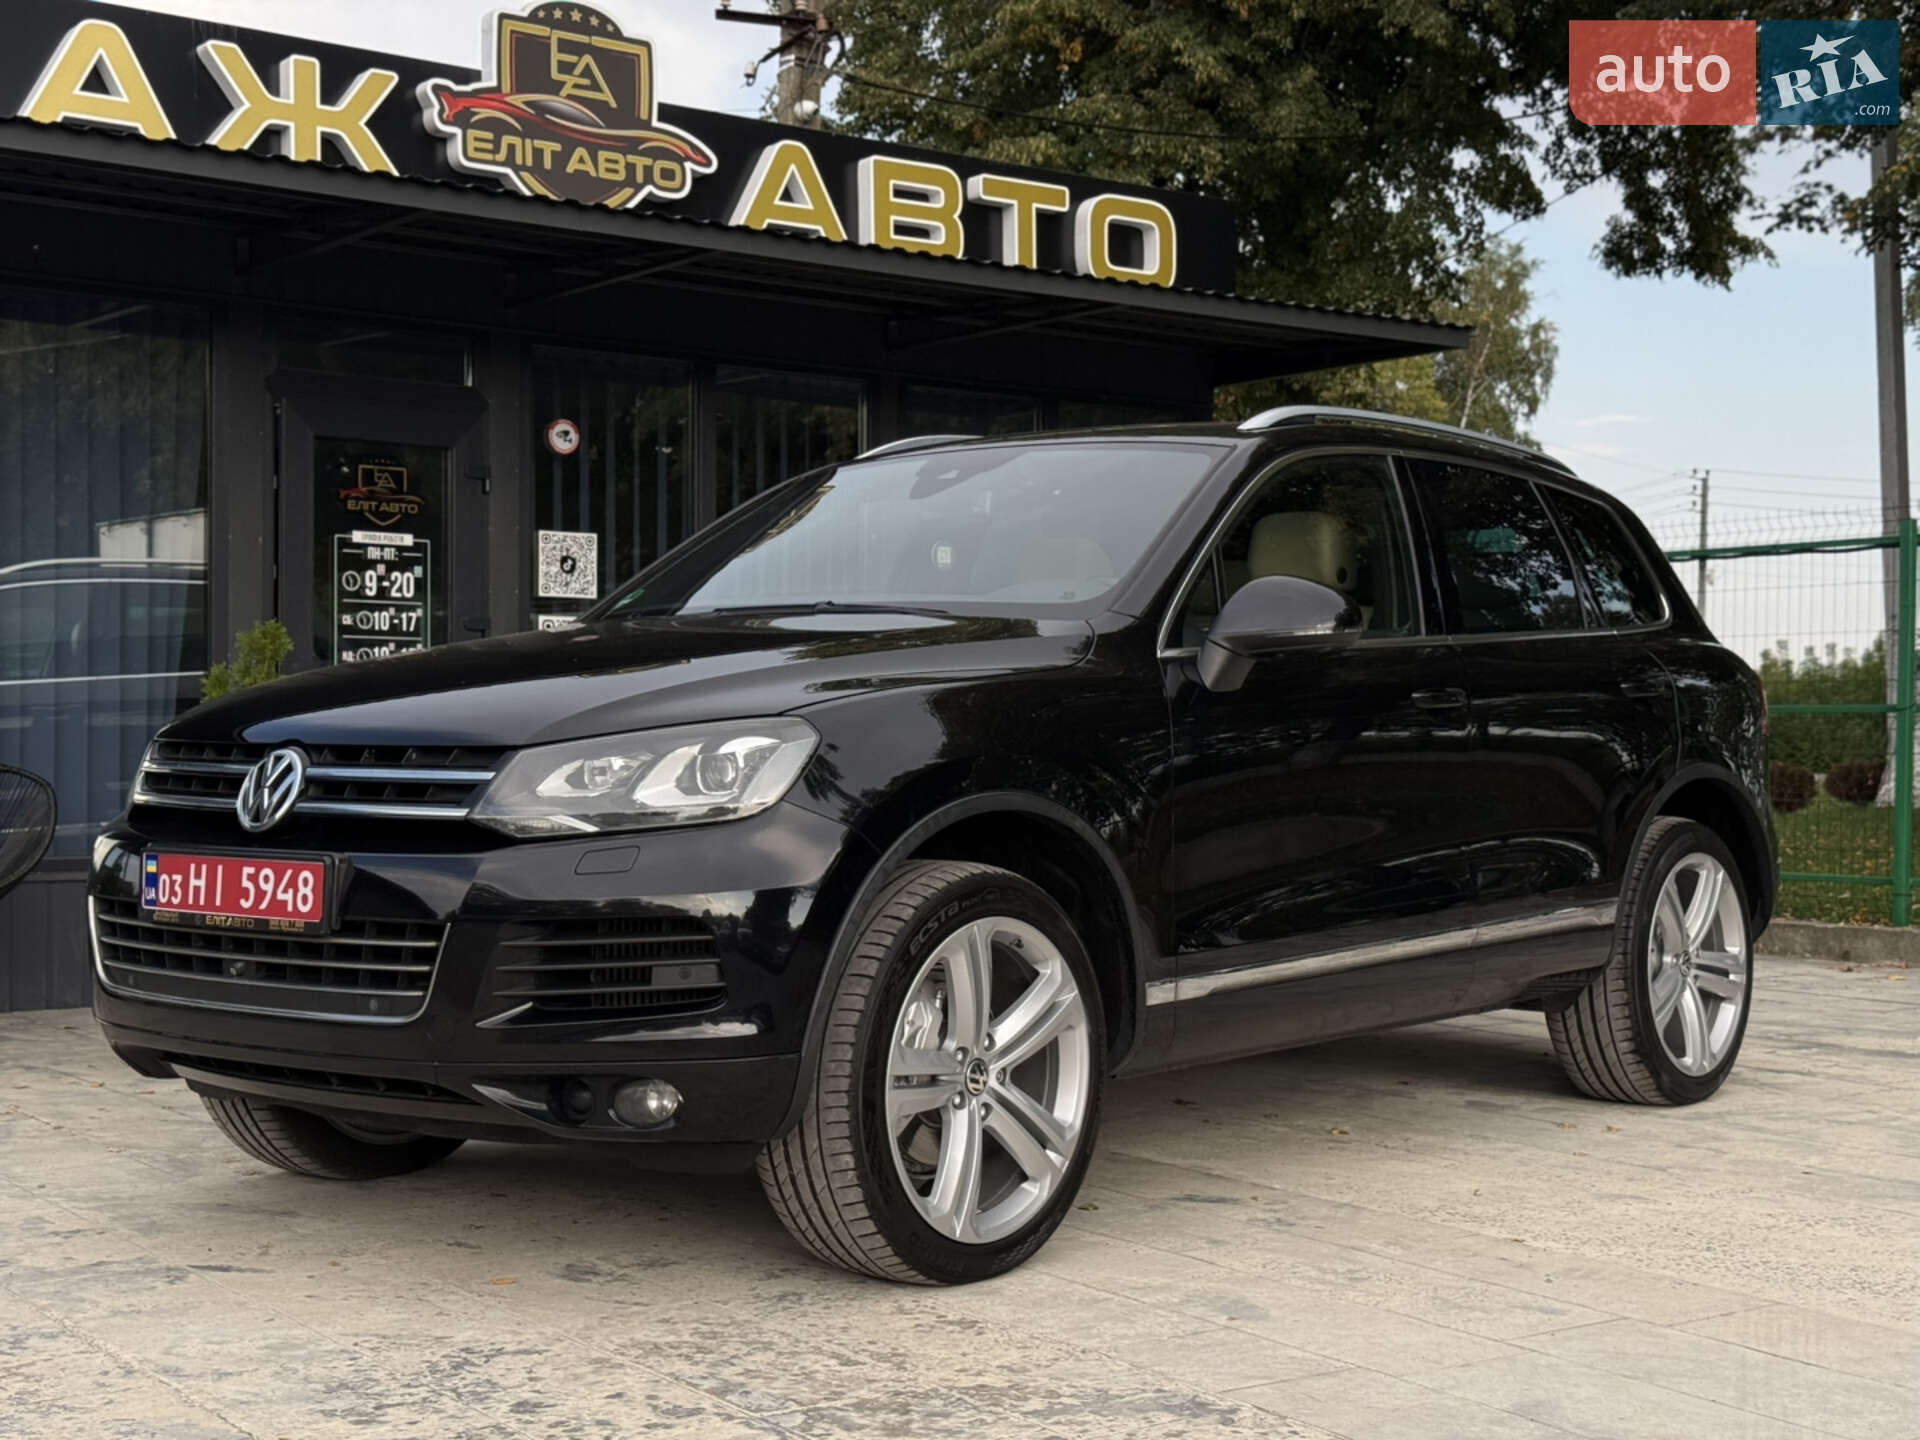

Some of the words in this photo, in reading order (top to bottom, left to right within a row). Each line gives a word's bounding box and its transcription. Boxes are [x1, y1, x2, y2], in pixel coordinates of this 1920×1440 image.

[466, 128, 562, 170] ЕЛІТ
[565, 146, 683, 189] АВТО
[728, 139, 1177, 288] АВТО
[379, 502, 418, 514] АВТО
[144, 886, 156, 899] UA
[239, 866, 314, 913] 5948
